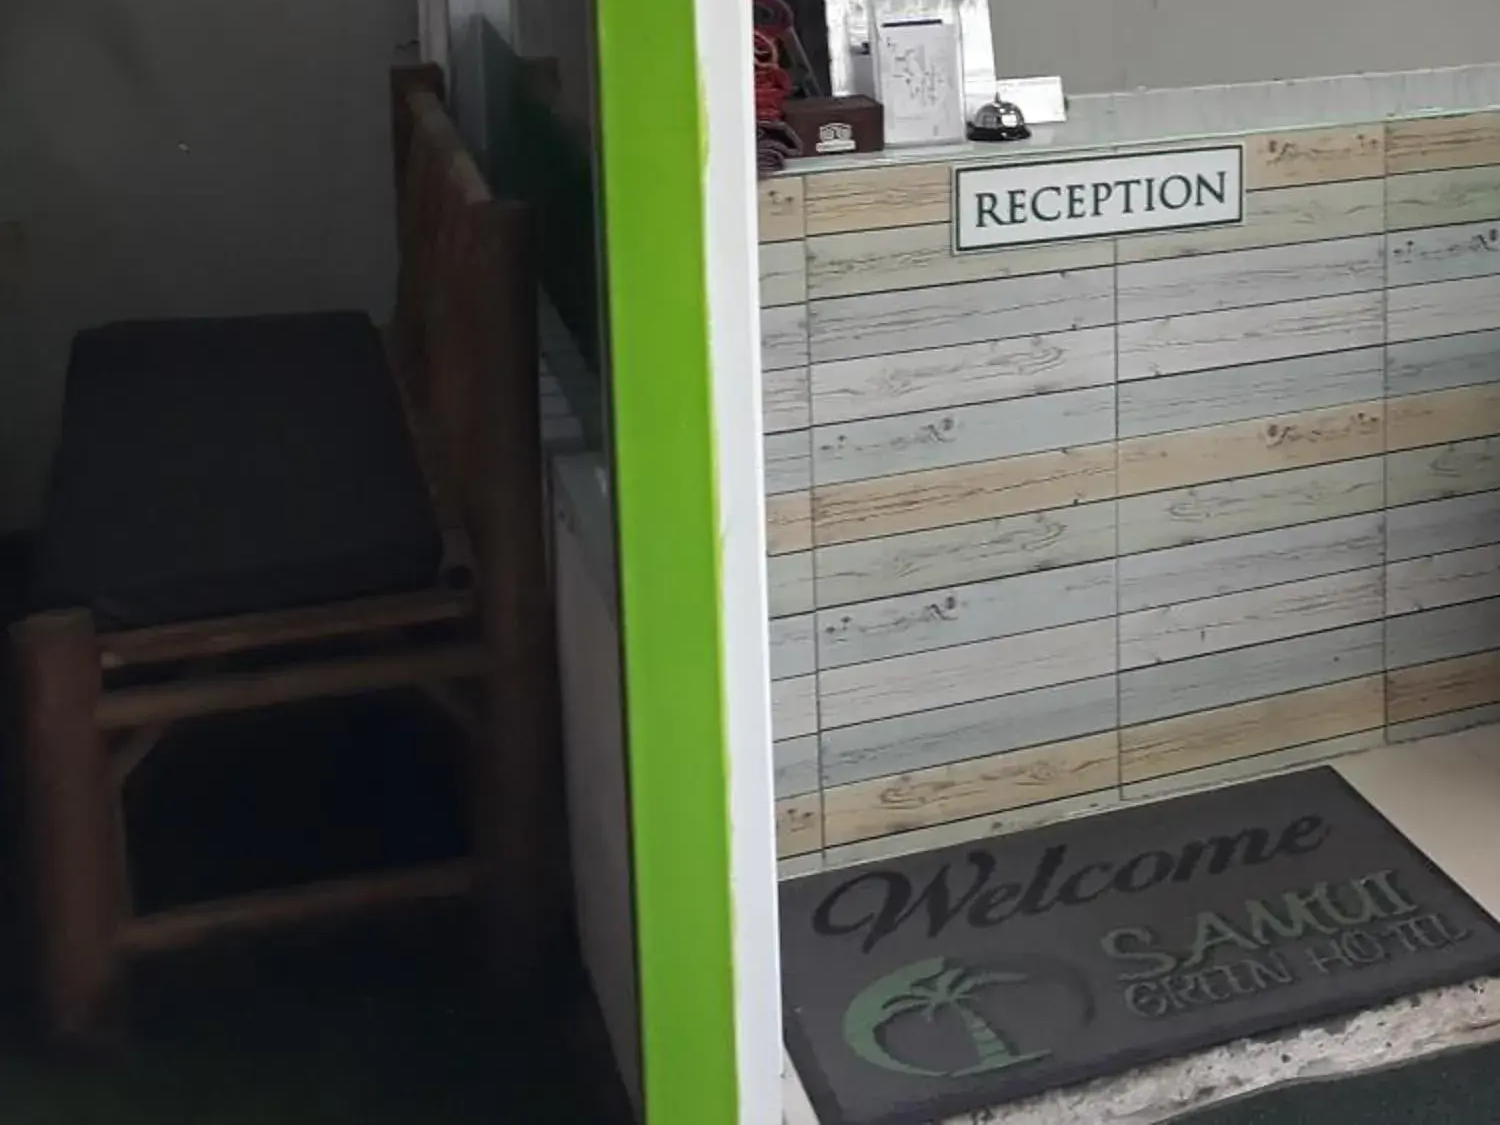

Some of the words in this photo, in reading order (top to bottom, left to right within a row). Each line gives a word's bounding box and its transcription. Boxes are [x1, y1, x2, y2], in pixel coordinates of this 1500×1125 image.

[974, 171, 1228, 229] RECEPTION
[811, 812, 1333, 955] Welcome
[1101, 868, 1422, 980] SAMUI
[1305, 909, 1478, 973] HOTEL
